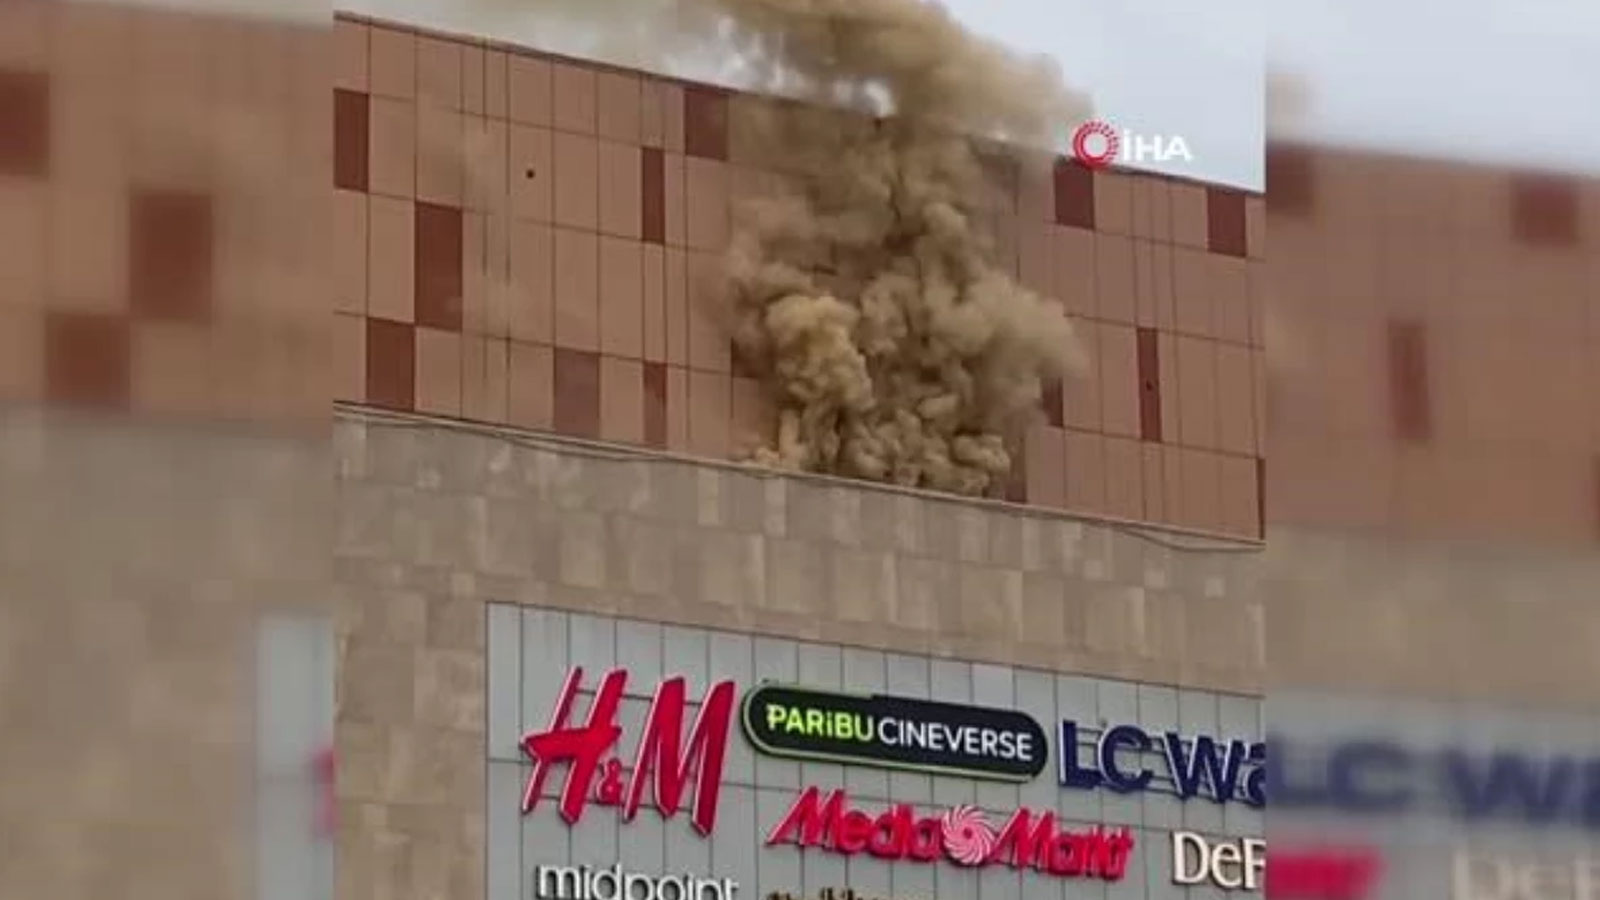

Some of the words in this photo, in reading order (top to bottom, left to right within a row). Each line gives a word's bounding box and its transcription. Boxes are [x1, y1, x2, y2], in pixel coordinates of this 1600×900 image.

[519, 665, 736, 838] H&M
[877, 716, 1033, 762] CINEVERSE
[1059, 719, 1154, 793] LC
[765, 786, 945, 863] Media
[536, 863, 739, 900] midpoint
